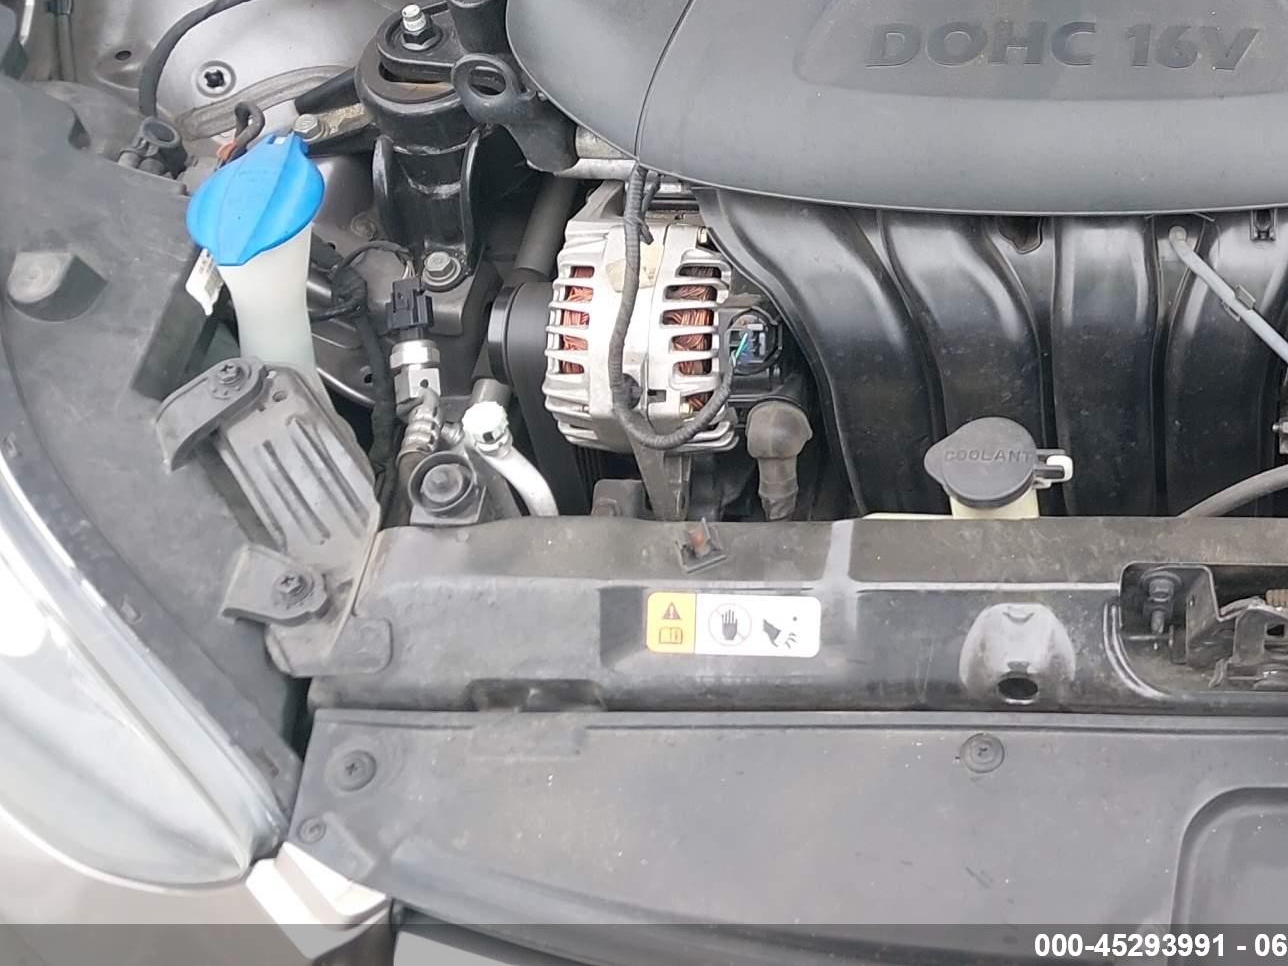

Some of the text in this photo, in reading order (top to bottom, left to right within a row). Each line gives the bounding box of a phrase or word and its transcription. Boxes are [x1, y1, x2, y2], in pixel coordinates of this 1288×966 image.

[865, 20, 1260, 70] DOHC 16V
[944, 448, 1034, 464] COOLANT
